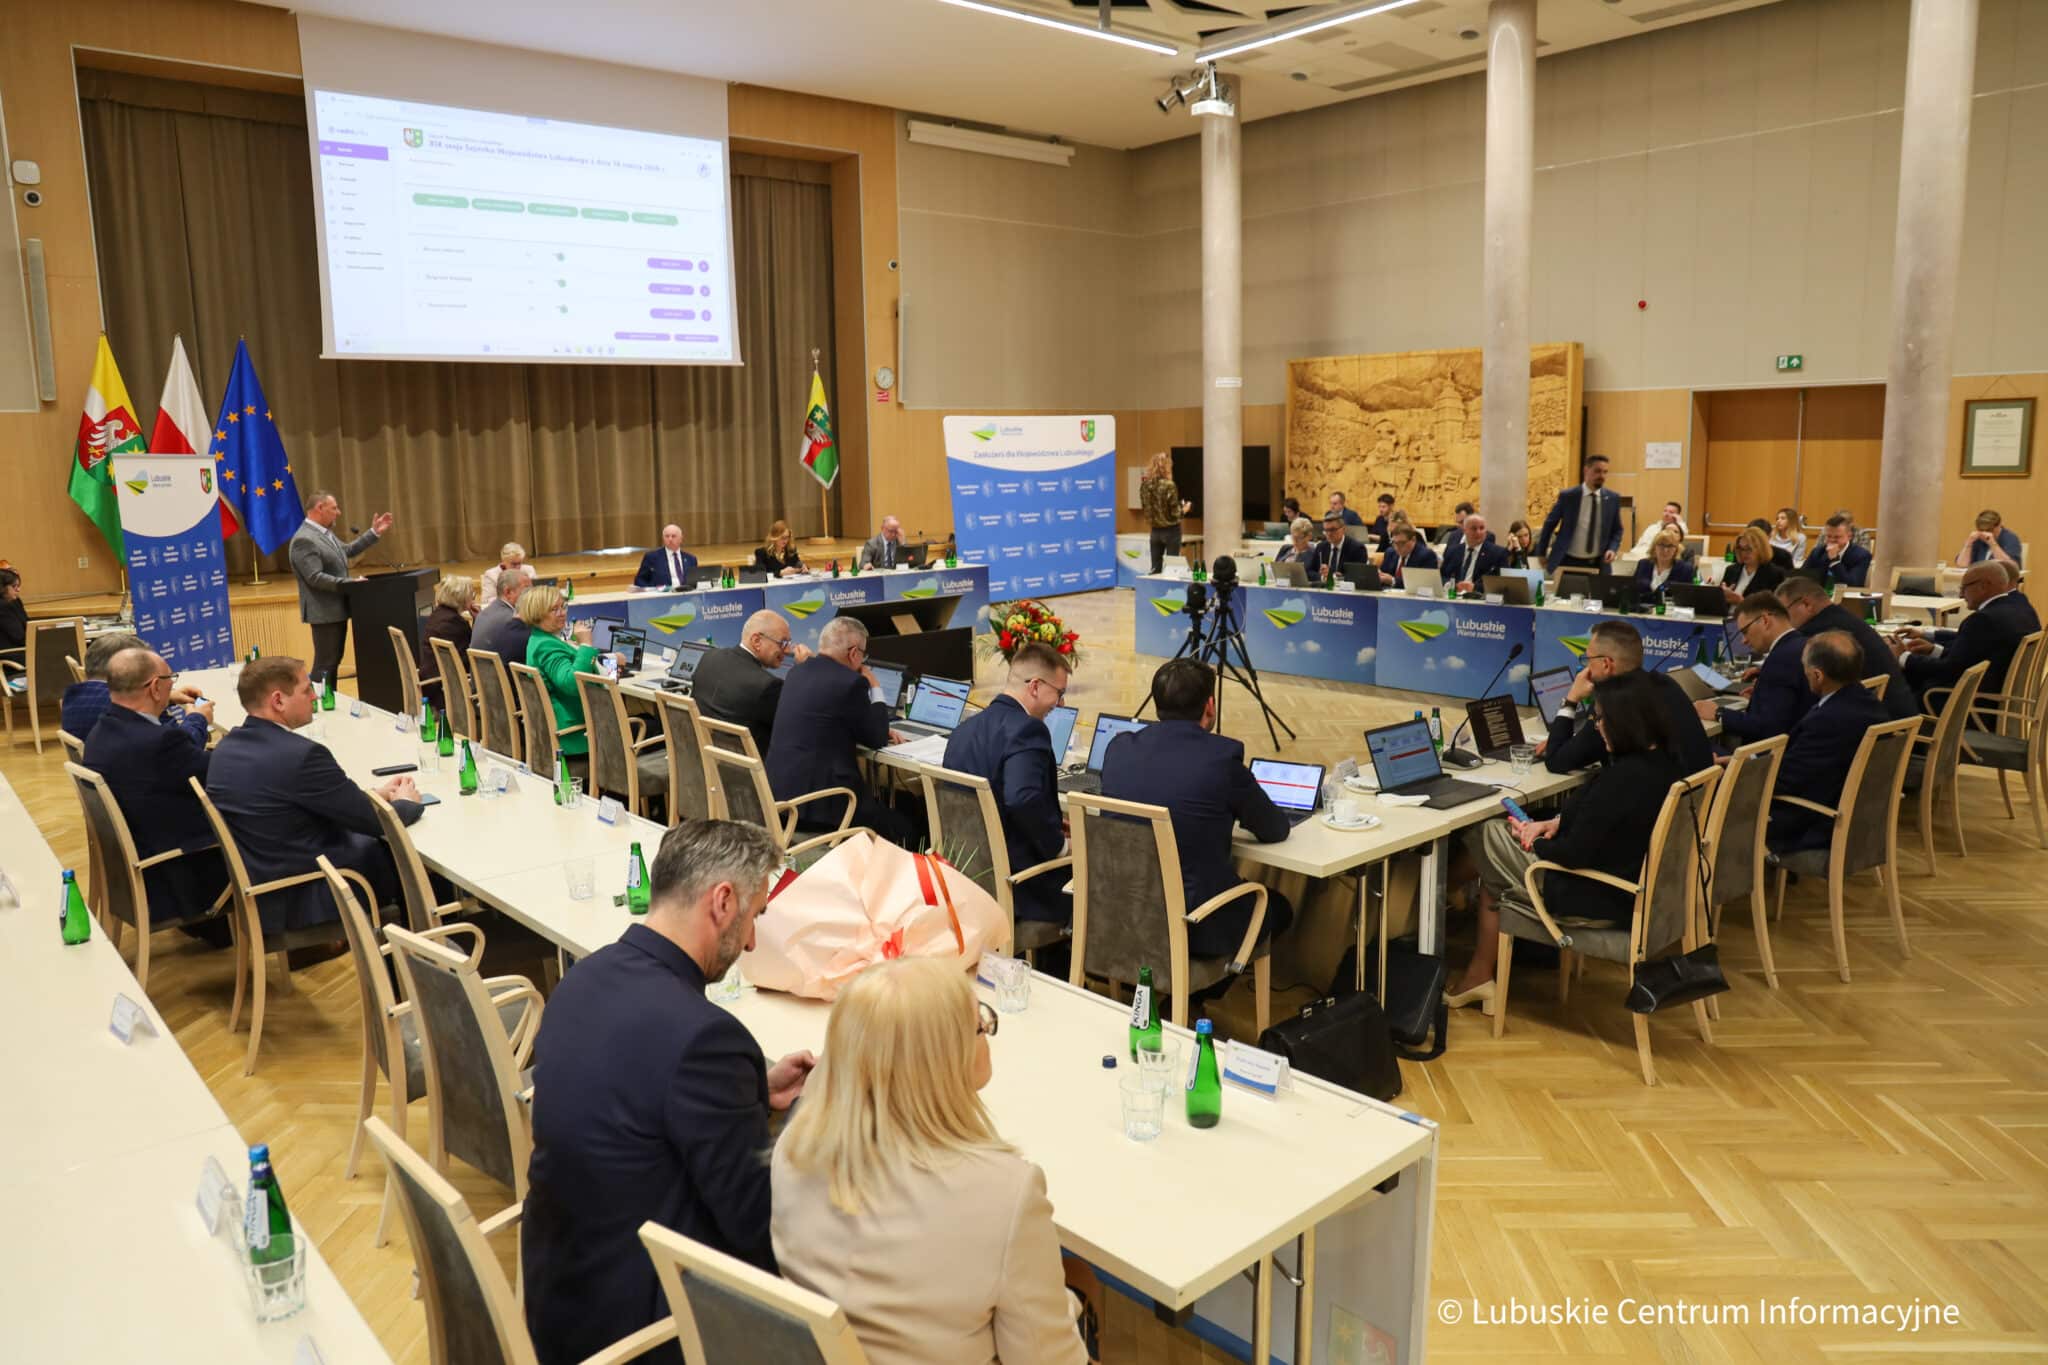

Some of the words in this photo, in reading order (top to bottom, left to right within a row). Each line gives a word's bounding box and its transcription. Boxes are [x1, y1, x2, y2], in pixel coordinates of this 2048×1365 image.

[942, 578, 974, 589] Lubuskie
[830, 589, 866, 601] Lubuskie
[702, 601, 743, 616] Lubuskie
[1311, 605, 1354, 619] Lubuskie
[1455, 618, 1506, 632] Lubuskie
[1641, 635, 1688, 650] buskie
[1133, 989, 1144, 1023] KINGA
